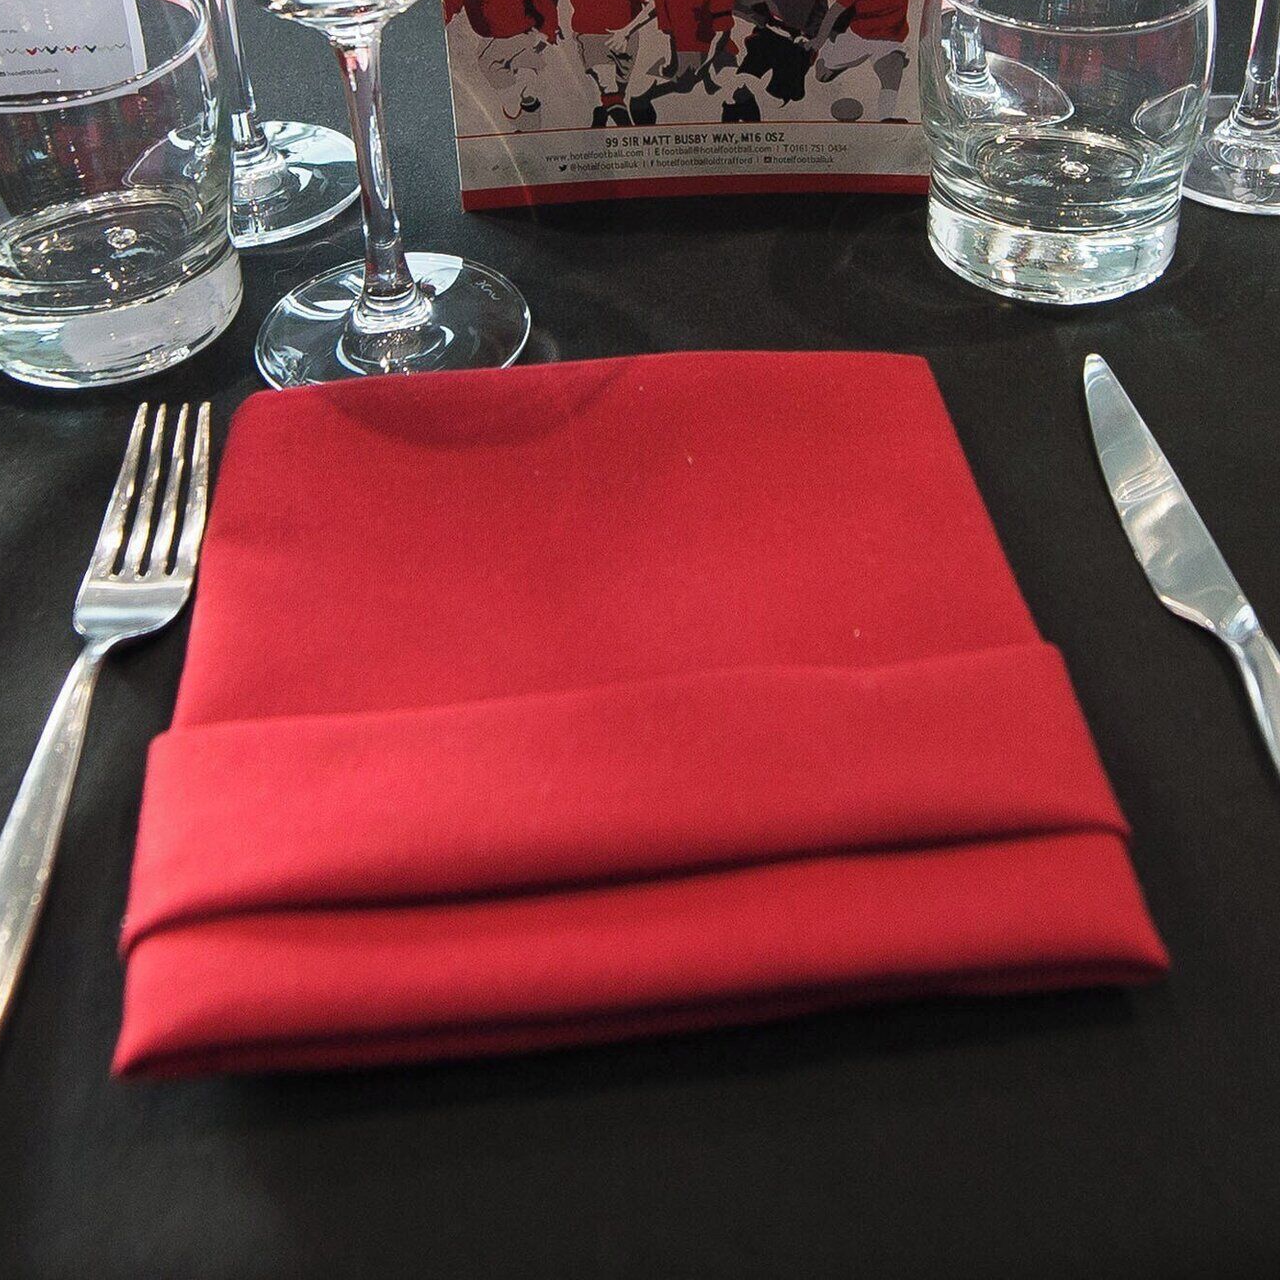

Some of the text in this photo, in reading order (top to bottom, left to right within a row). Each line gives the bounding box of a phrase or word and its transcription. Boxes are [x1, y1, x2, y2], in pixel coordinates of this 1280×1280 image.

[605, 132, 761, 148] 99 SIR MATT BUSBY WAY, M16
